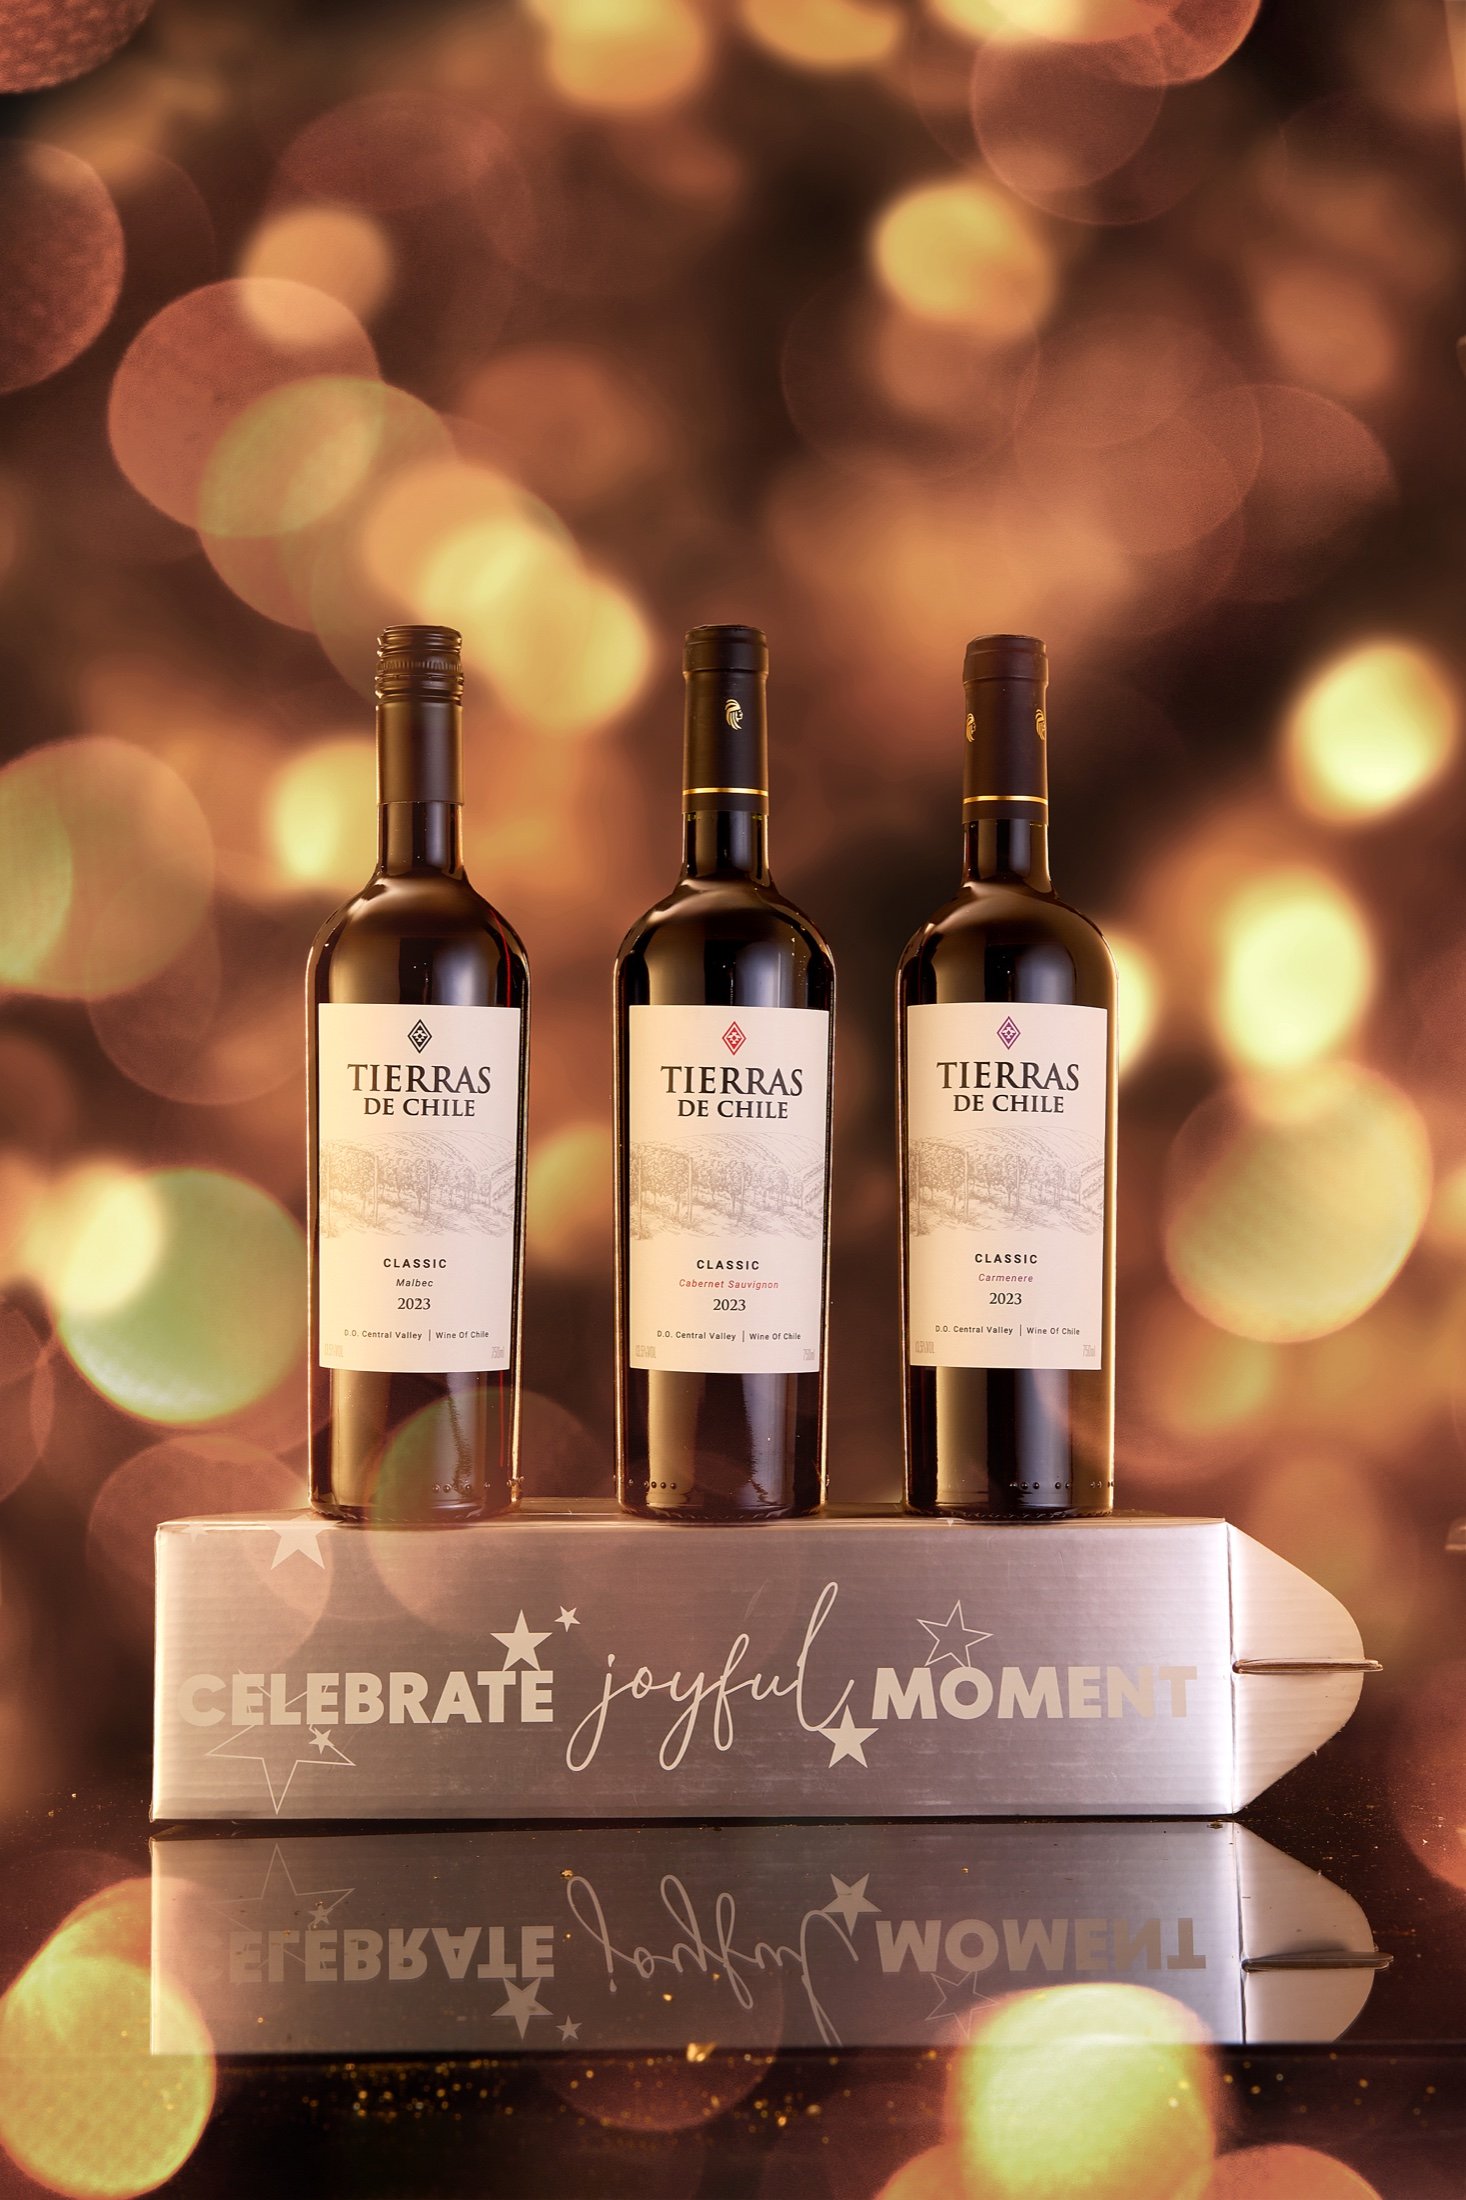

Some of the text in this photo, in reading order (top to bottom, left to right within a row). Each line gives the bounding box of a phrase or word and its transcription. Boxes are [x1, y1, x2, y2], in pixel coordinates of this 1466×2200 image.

[347, 1063, 491, 1095] TIERRAS
[660, 1065, 803, 1097] TIERRAS
[936, 1061, 1080, 1092] TIERRAS
[363, 1097, 476, 1117] DE CHILE
[677, 1099, 789, 1119] DE CHILE
[953, 1094, 1064, 1113] DE CHILE
[383, 1257, 447, 1269] CLASSIC
[696, 1259, 760, 1271] CLASSIC
[974, 1253, 1038, 1265] CLASSIC
[395, 1278, 434, 1288] Malbec
[678, 1278, 779, 1292] Cabernet Sauvignon
[978, 1273, 1034, 1283] Carmenere
[397, 1297, 431, 1311] 2023
[712, 1298, 747, 1312] 2023
[988, 1292, 1023, 1306] 2023
[362, 1330, 393, 1339] Central
[394, 1331, 423, 1341] Valley
[435, 1331, 457, 1339] Wine
[459, 1330, 468, 1339] Of
[470, 1330, 490, 1338] Chile
[656, 1330, 801, 1342] D.O. Central Valley Wine Of Chile
[953, 1325, 984, 1334] Central
[986, 1326, 1014, 1336] Valley
[1026, 1326, 1048, 1335] Wine
[1050, 1327, 1060, 1335] Of
[1061, 1327, 1081, 1336] Chile
[178, 1580, 1198, 1772] CELEBRATE joyful MOMENT
